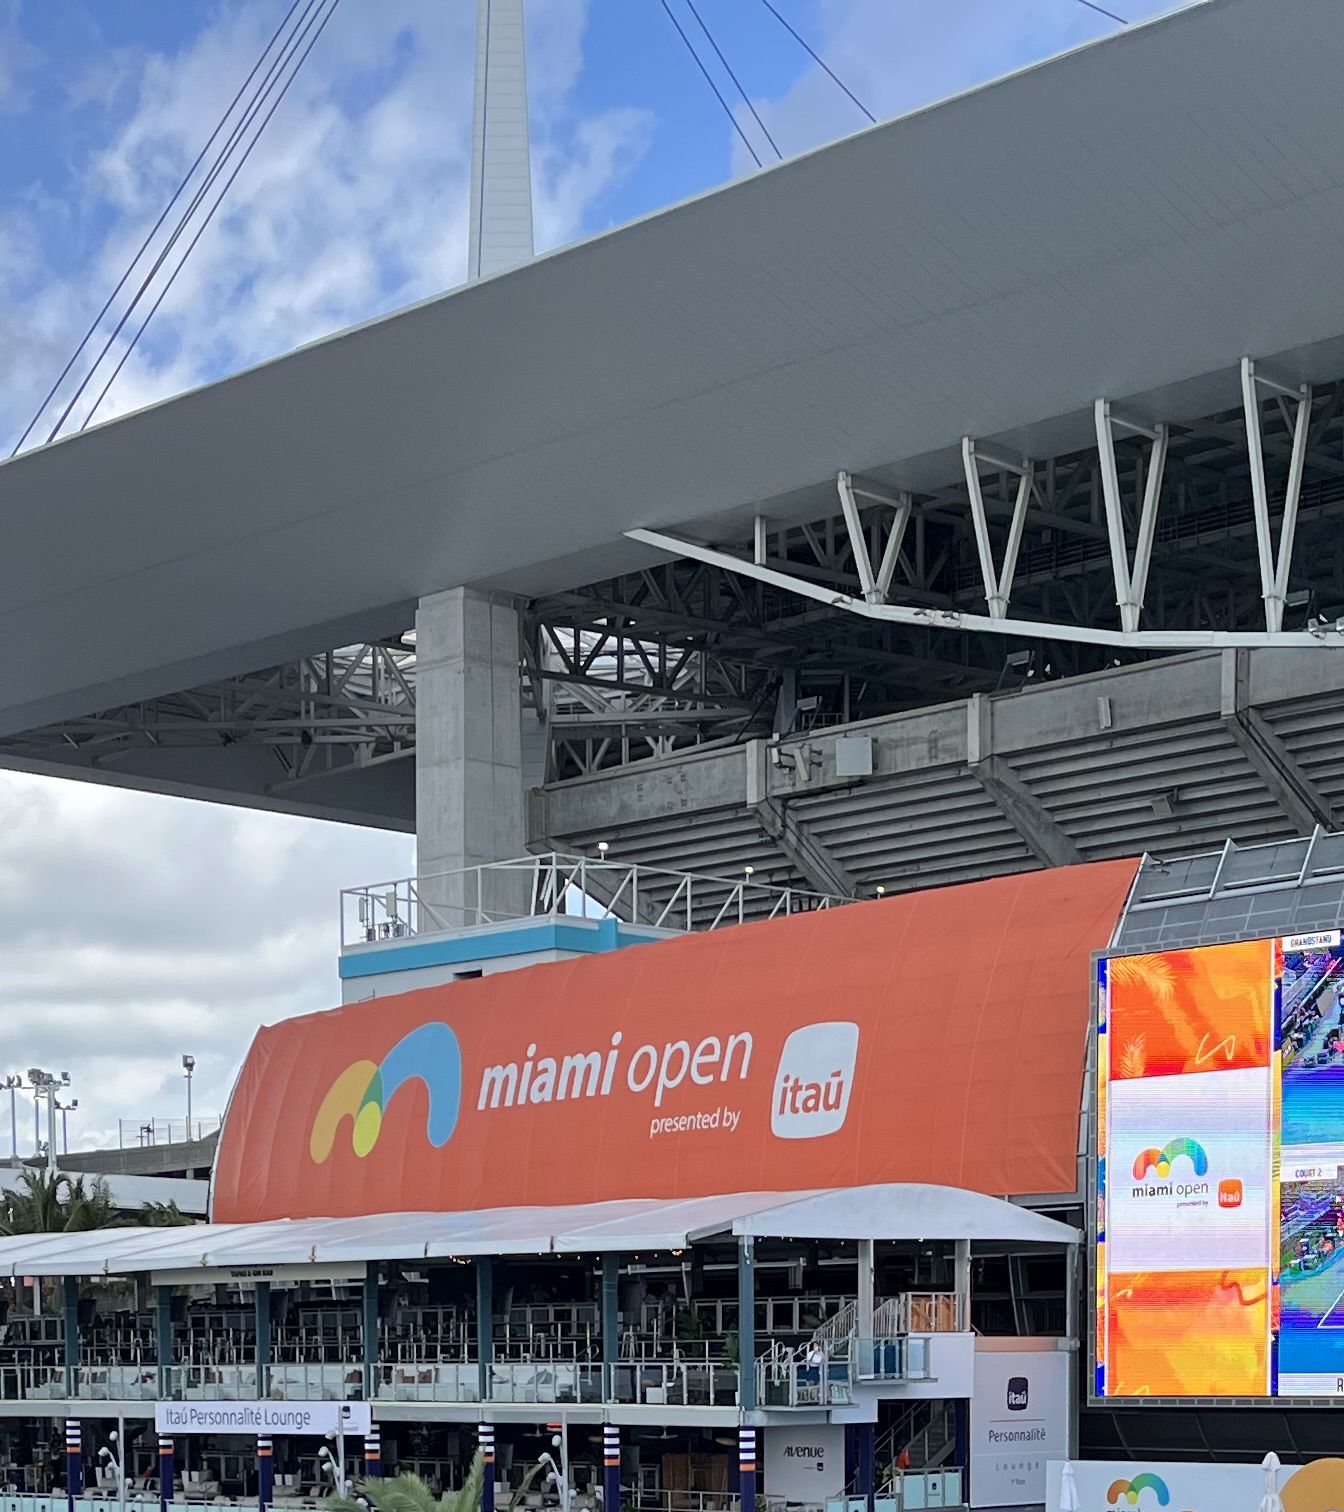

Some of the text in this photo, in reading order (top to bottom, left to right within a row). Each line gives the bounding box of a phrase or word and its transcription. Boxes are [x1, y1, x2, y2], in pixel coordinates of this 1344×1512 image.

[476, 1030, 754, 1112] miami open
[778, 1070, 845, 1116] itaú
[649, 1107, 741, 1139] presented by
[1132, 1182, 1209, 1198] miami open
[166, 1407, 311, 1430] Itaú Personnalité Lounge
[988, 1427, 1046, 1443] Personnalité
